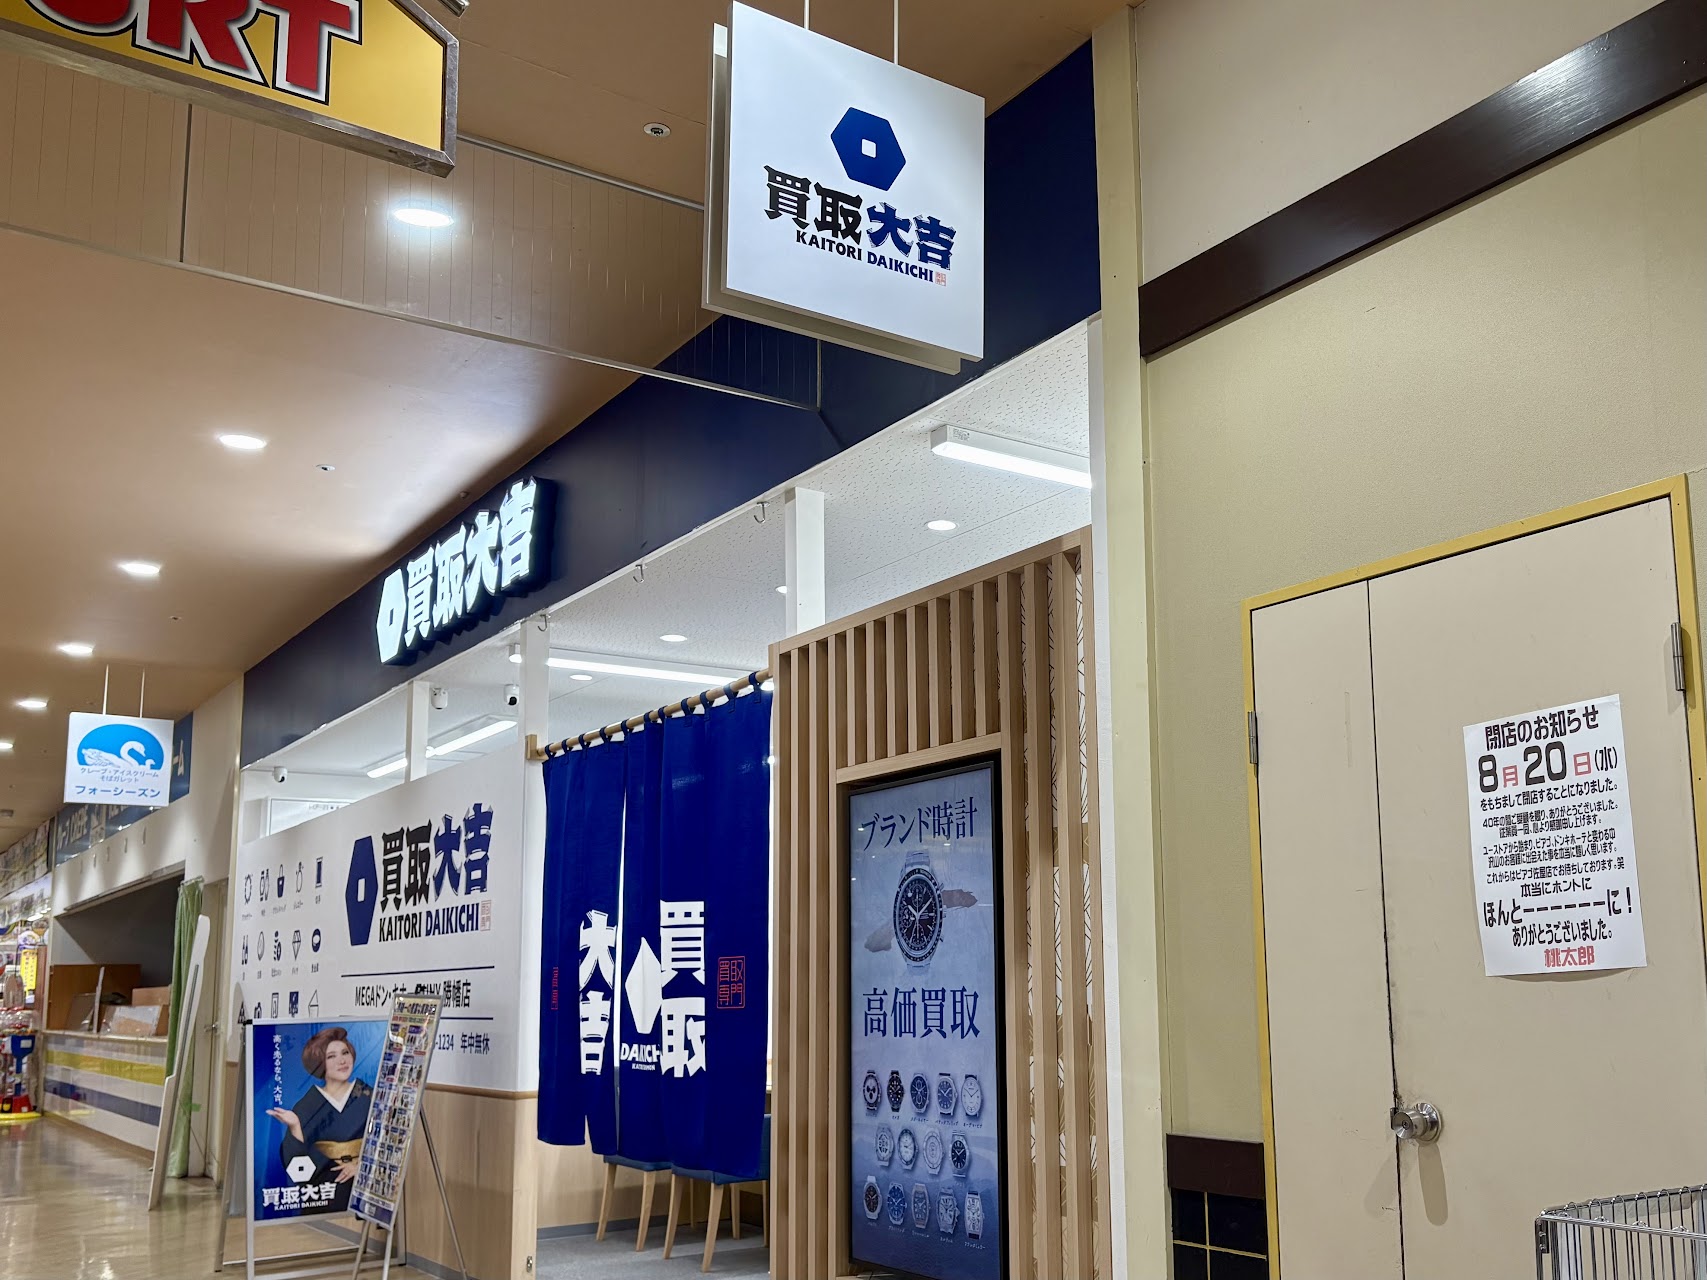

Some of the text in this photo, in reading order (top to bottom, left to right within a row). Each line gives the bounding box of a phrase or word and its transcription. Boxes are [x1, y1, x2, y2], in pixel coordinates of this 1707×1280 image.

[763, 165, 956, 270] 買取大吉
[796, 230, 863, 261] KAITORI
[867, 251, 934, 282] DAIKICHI
[404, 476, 537, 647] 買取大吉
[1485, 705, 1599, 751] 閉店のお知らせ
[75, 785, 160, 798] フォーシーズン
[1480, 778, 1617, 811] をもちまして閉店することになりました。
[861, 797, 977, 851] ブランド時計
[380, 803, 493, 913] 買取大吉
[1520, 877, 1592, 898] 本当にホントに
[379, 912, 422, 942] KAITORI
[425, 903, 479, 936] DAIKICHI
[1512, 918, 1612, 947] ありがとうございました。
[1544, 946, 1595, 967] 桃太郎
[579, 909, 617, 1075] 大吉
[660, 900, 706, 1077] 買取
[862, 985, 980, 1039] 高価買取
[461, 1032, 490, 1055] 年中無休
[262, 1181, 337, 1207] 買取大吉
[274, 1200, 328, 1211] KAITORI DAIKICHI
